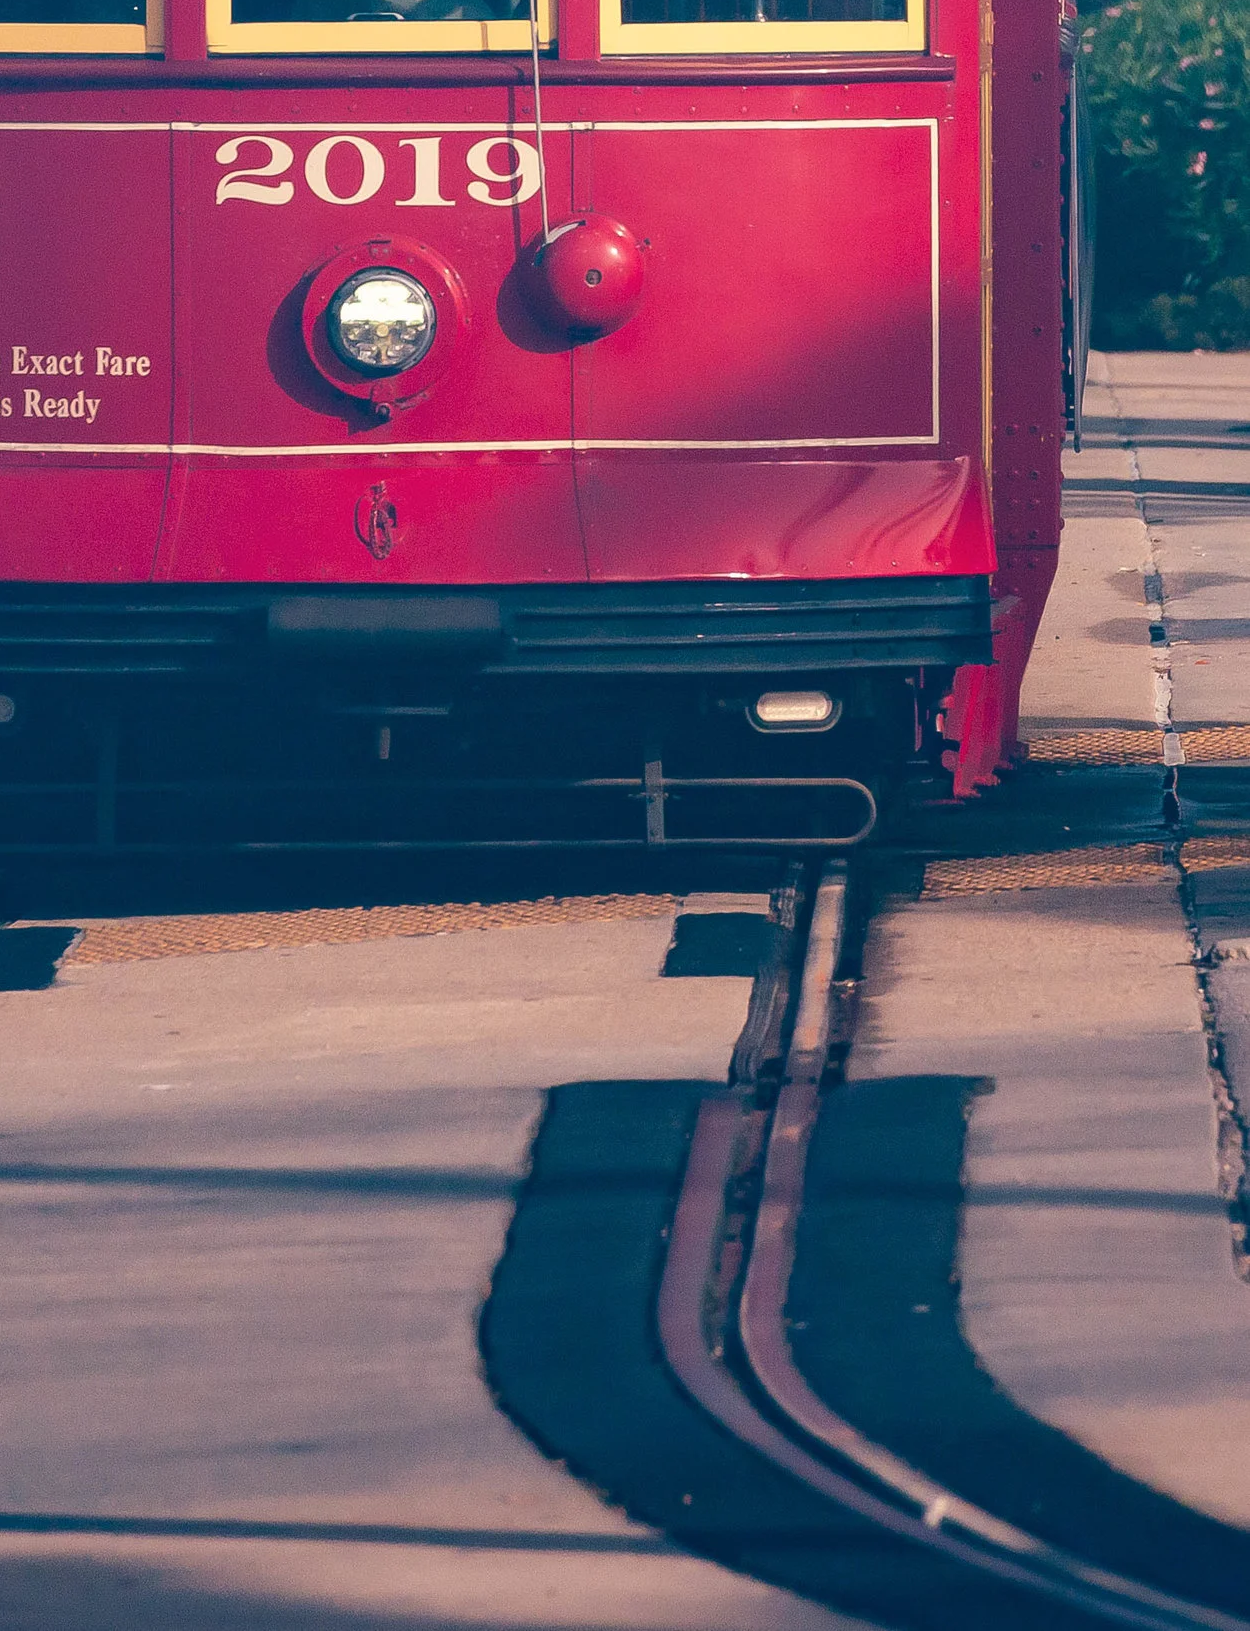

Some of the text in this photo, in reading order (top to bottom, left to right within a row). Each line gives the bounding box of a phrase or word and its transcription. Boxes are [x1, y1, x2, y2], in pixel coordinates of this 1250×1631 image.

[215, 135, 542, 207] 2019
[11, 346, 84, 376] Exact
[95, 346, 151, 376] Fare
[23, 388, 101, 424] Ready
